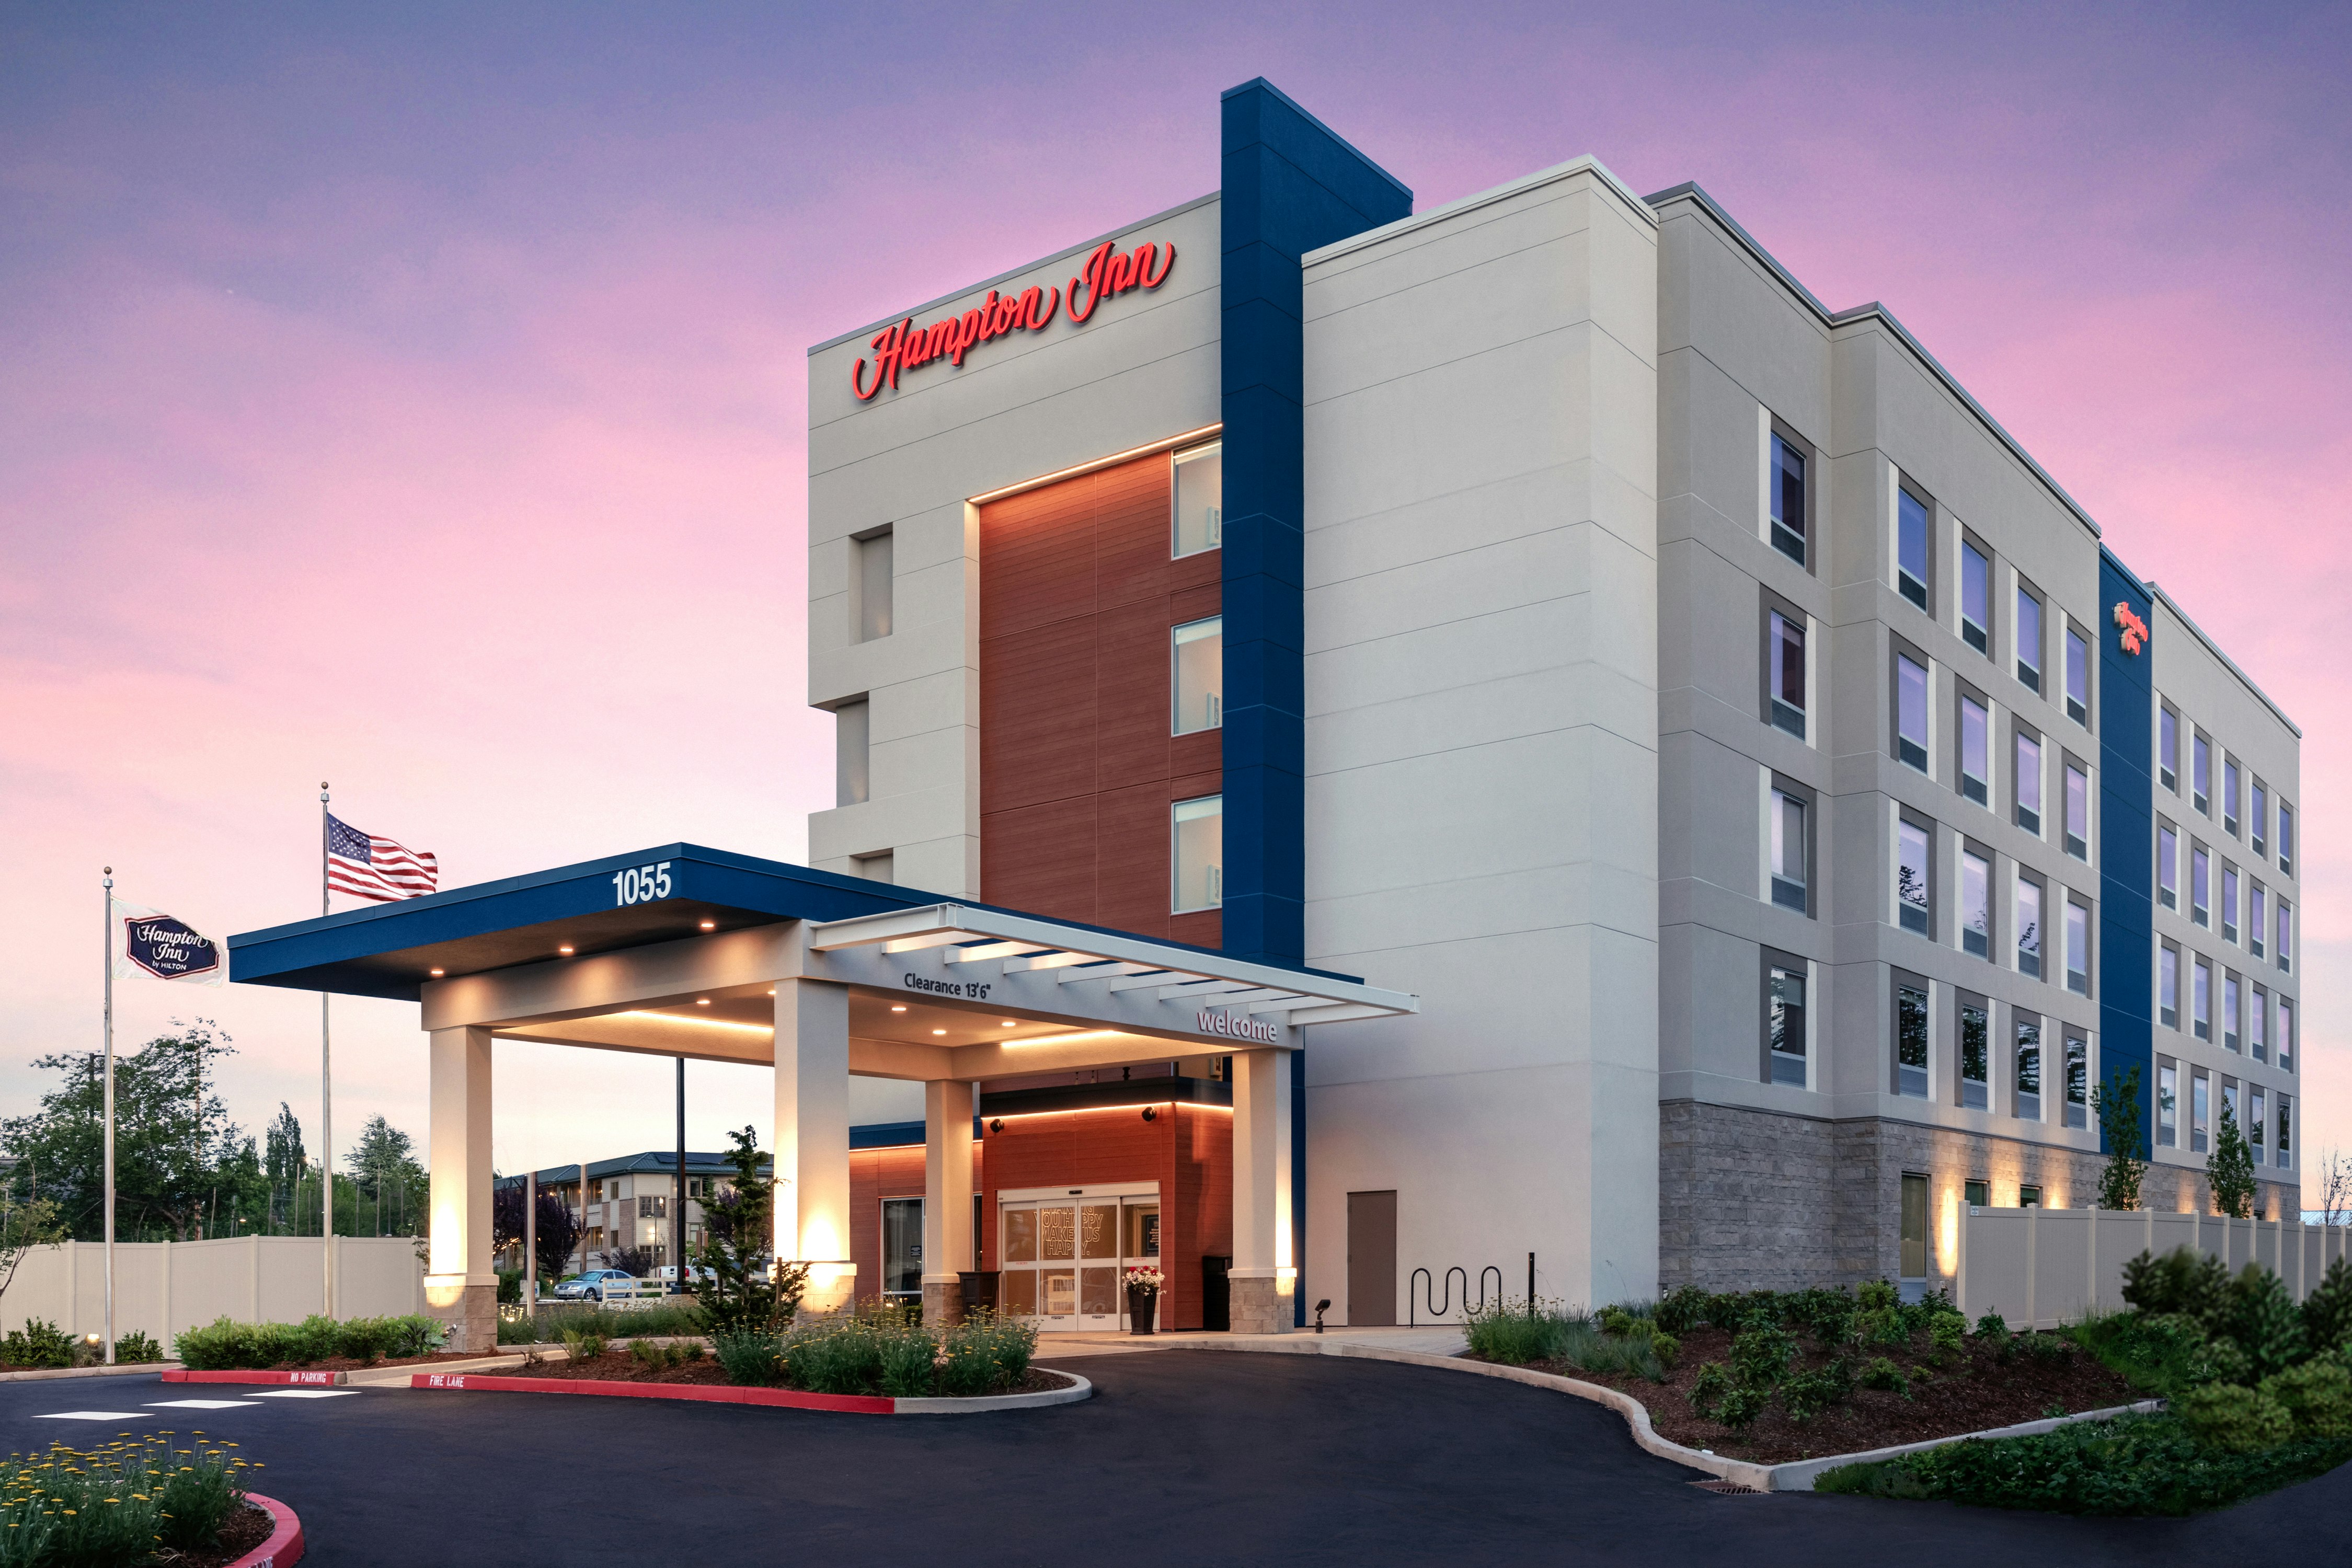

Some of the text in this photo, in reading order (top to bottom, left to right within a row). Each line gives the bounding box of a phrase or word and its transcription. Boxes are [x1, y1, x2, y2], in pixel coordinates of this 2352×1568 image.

[852, 241, 1176, 401] Hampton Inn
[613, 861, 671, 906] 1055
[137, 925, 208, 948] Hampton
[153, 943, 189, 962] Inn
[161, 962, 187, 971] HILTON
[904, 973, 991, 999] Clearance 13'6"
[1197, 1009, 1278, 1042] welcome
[1085, 1227, 1100, 1242] US
[1047, 1240, 1090, 1255] HAPY.
[290, 1373, 327, 1383] NO PARKING
[429, 1375, 464, 1388] FIRE LANE
